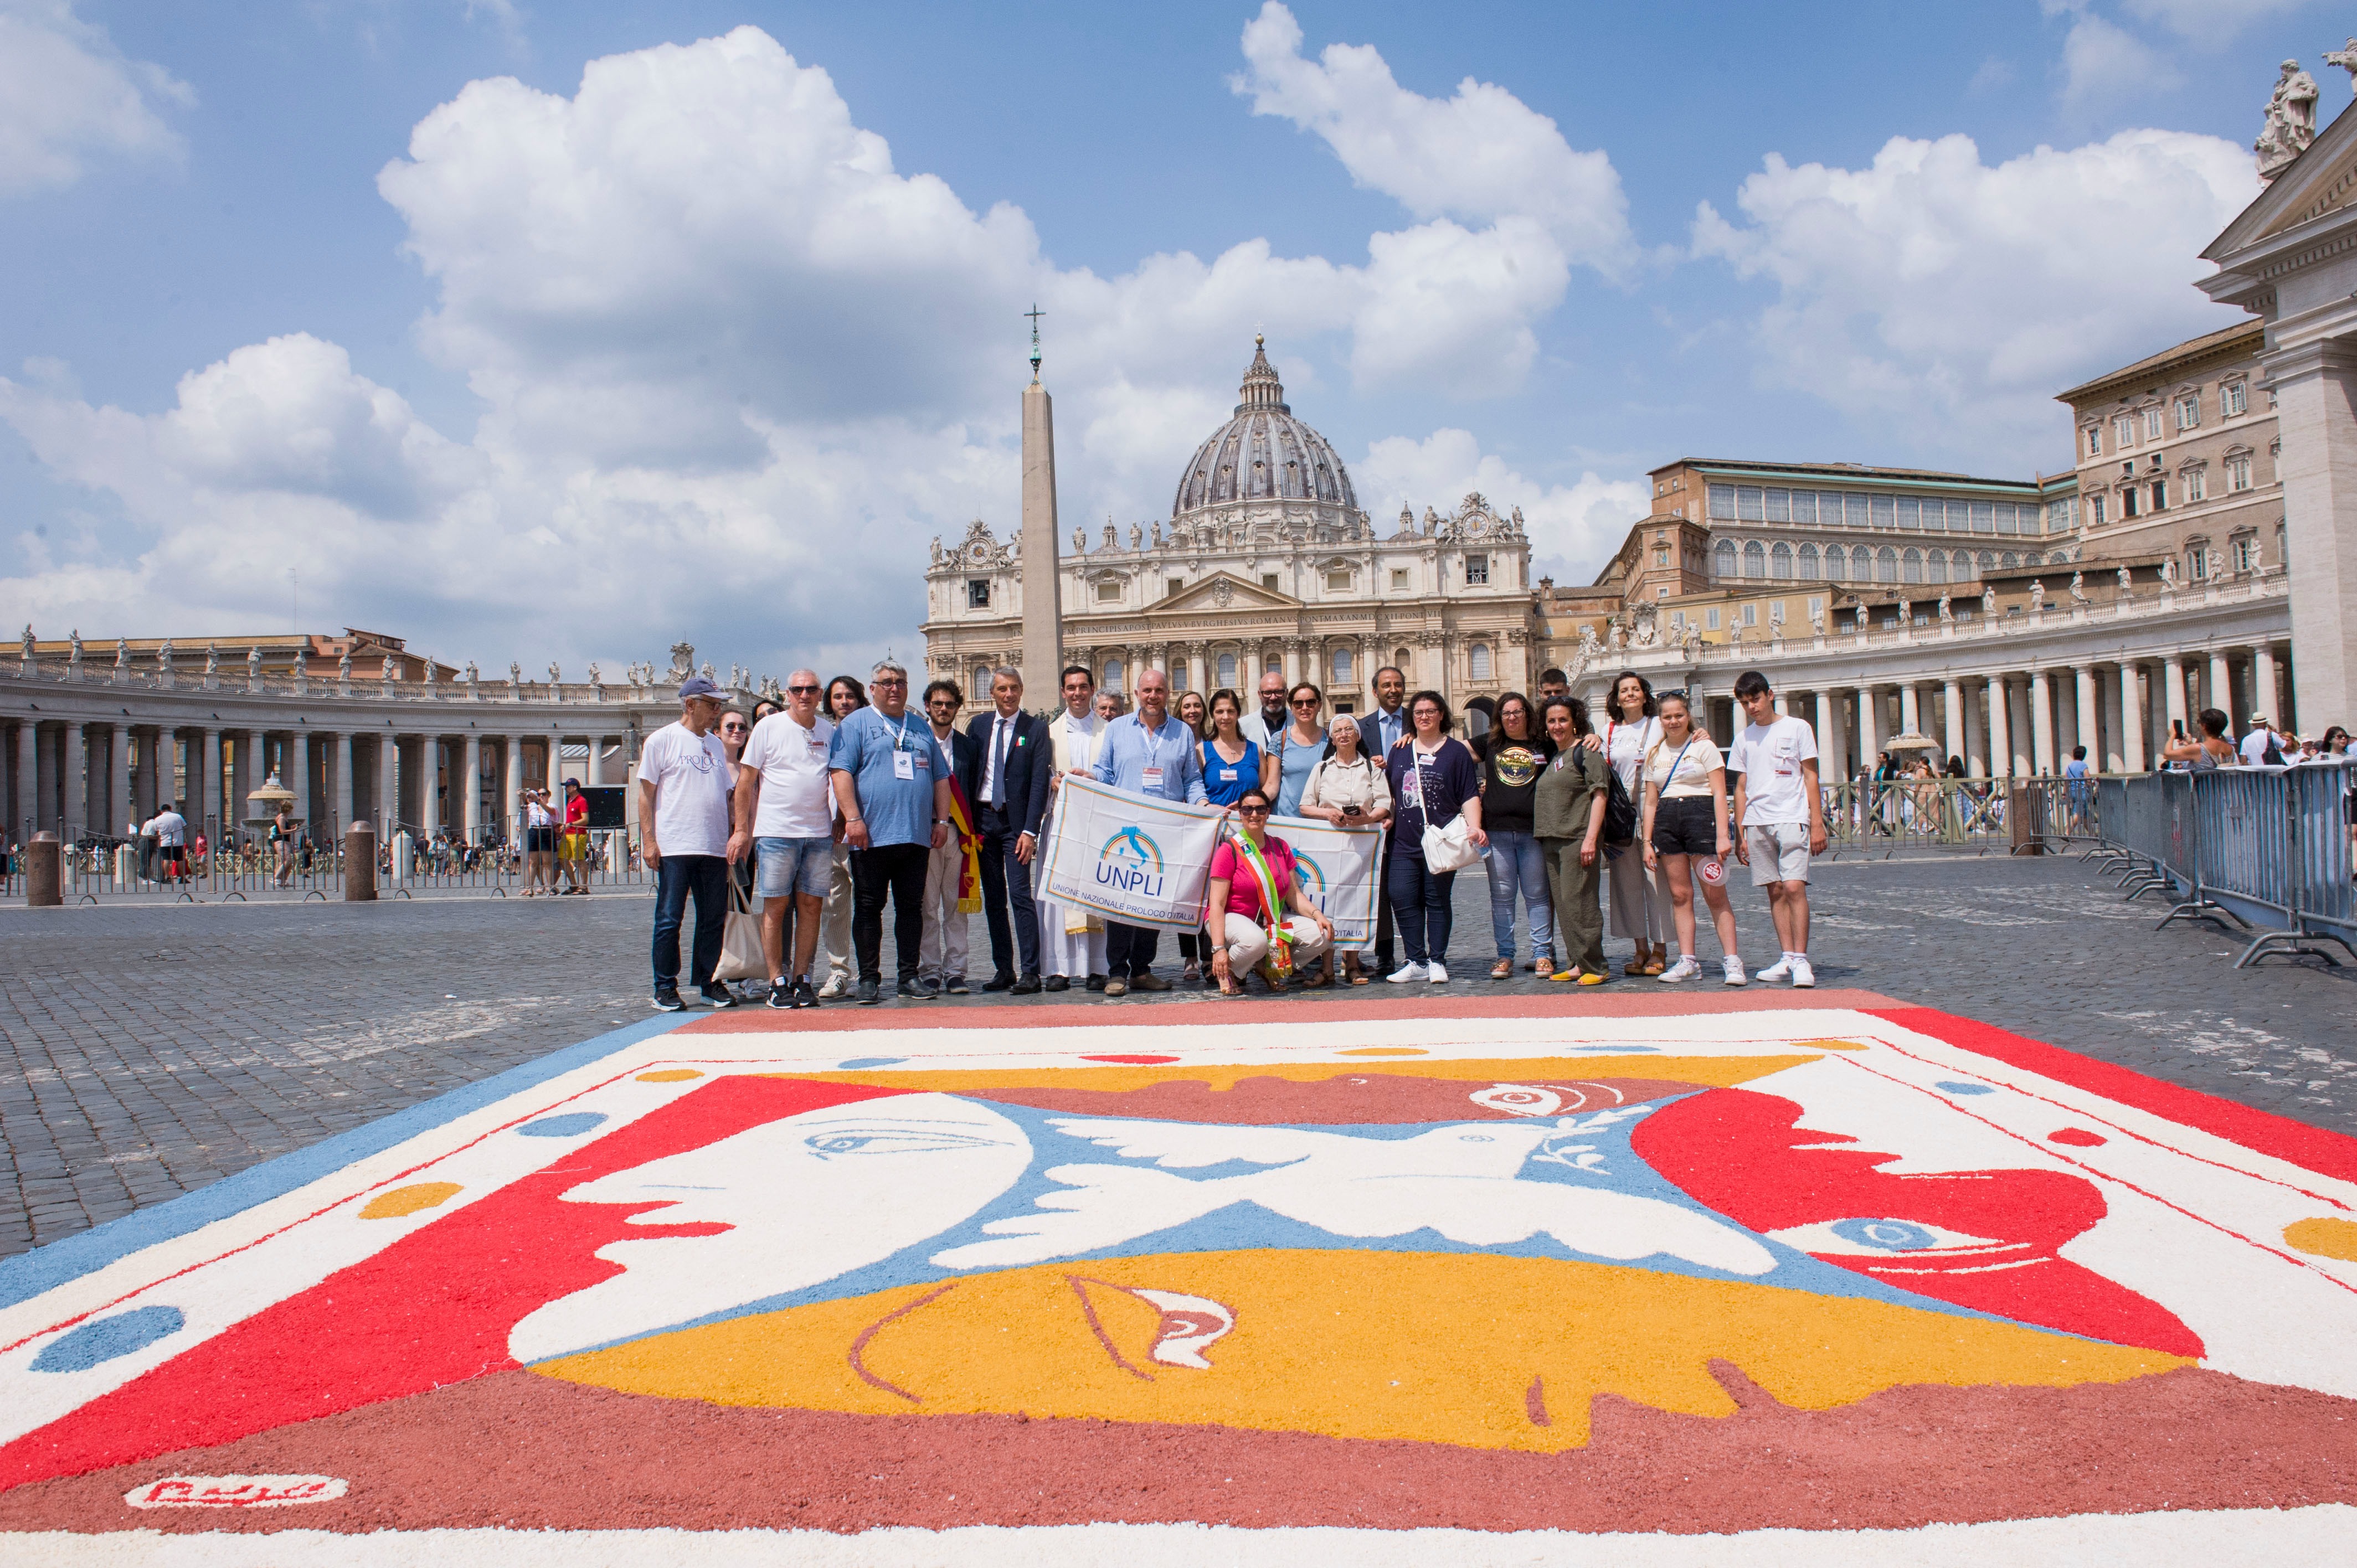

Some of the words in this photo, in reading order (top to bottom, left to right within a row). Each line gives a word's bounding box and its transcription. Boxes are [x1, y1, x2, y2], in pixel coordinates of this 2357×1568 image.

[1075, 625, 1121, 633] PRINCIPIS
[1123, 623, 1151, 631] APOST
[1191, 617, 1248, 627] BVRGHESIVS
[1250, 616, 1297, 625] ROMANVS
[1096, 862, 1163, 896] UNPLI
[1052, 882, 1080, 896] UNIONE
[1081, 892, 1125, 910] NAZIONALE
[1126, 904, 1165, 918] PROLOCO
[1167, 911, 1195, 921] D'ITALIA
